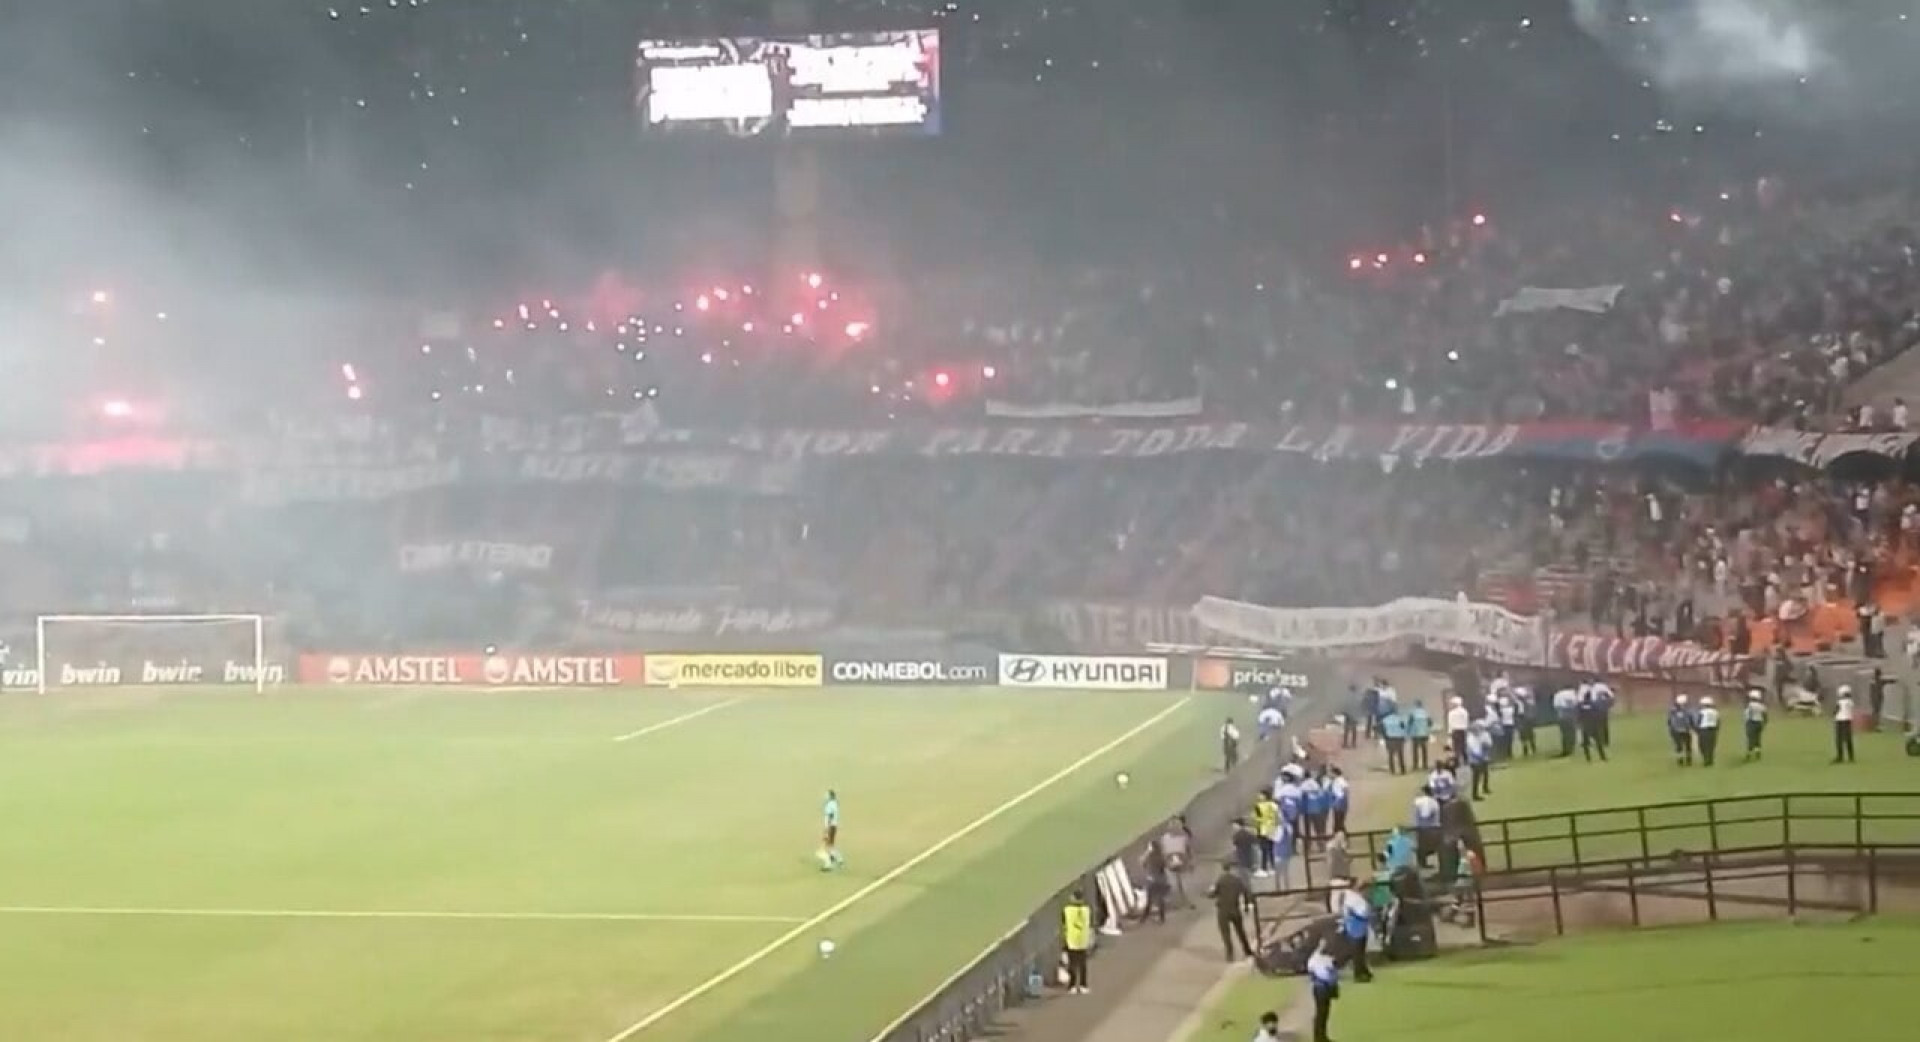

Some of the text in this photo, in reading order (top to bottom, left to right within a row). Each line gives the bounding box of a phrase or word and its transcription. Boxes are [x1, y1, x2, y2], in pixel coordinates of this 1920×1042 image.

[1102, 422, 1248, 457] TODA
[1388, 423, 1522, 460] VIDA
[1, 663, 38, 685] win
[61, 660, 121, 684] bwin
[356, 656, 463, 683] AMSTEL
[513, 656, 621, 683] AMSTEL
[681, 656, 818, 680] mercado libre
[1052, 662, 1163, 683] HYUNDAI
